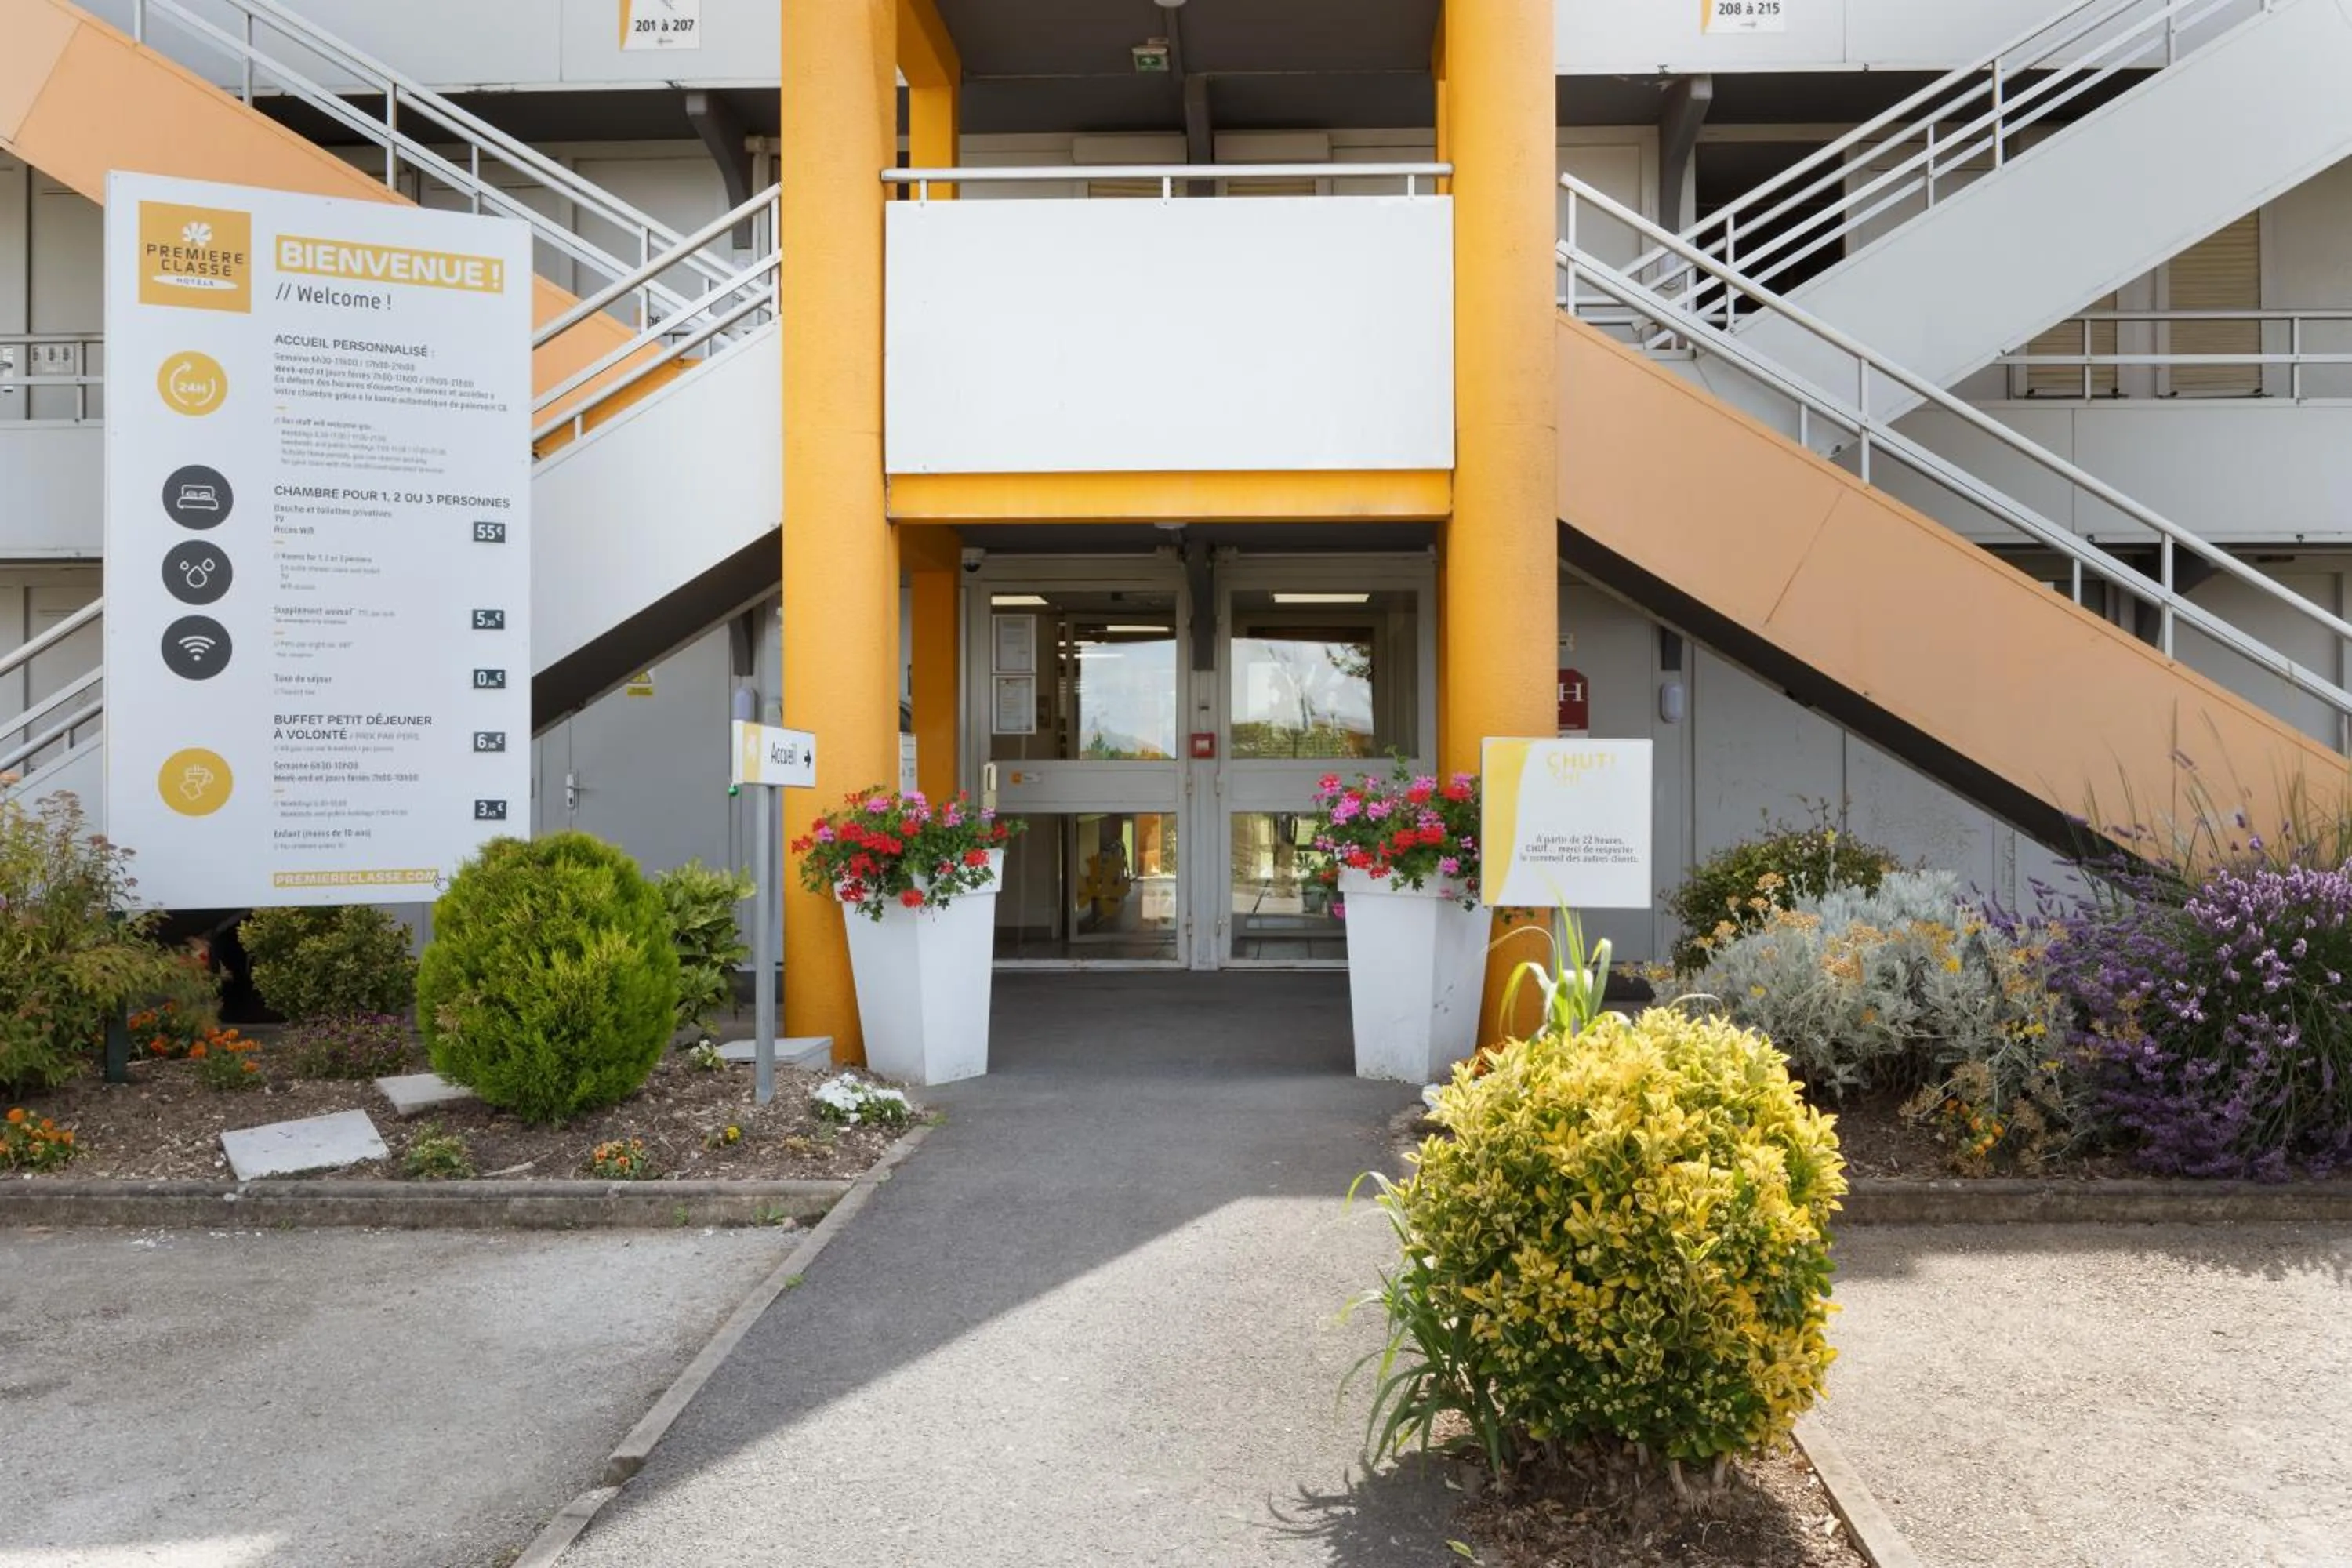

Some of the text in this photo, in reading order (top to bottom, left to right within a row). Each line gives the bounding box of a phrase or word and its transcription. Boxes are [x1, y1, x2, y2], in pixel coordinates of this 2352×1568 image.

[1719, 2, 1780, 15] 208 à 215
[635, 19, 695, 32] 201 à 207
[147, 243, 244, 265] PREMIERE
[161, 259, 232, 277] CLASSE
[281, 240, 500, 289] BIENVENUE !
[176, 278, 214, 287] HOTELS
[297, 284, 381, 310] Welcome
[275, 334, 329, 349] ACCUEIL
[333, 339, 427, 358] PERSONNALISÉ
[274, 485, 339, 499] CHAMBRE
[343, 489, 378, 502] POUR
[394, 492, 401, 503] 2
[405, 494, 423, 504] OU
[426, 495, 434, 505] 3
[437, 495, 510, 508] PERSONNES
[477, 524, 503, 539] 55€
[1558, 683, 1584, 702] H
[274, 713, 432, 726] BUFFET PETIT DÉJEUNER
[274, 728, 283, 739] À
[287, 728, 347, 740] VOLONTÉ
[1582, 836, 1592, 844] 22
